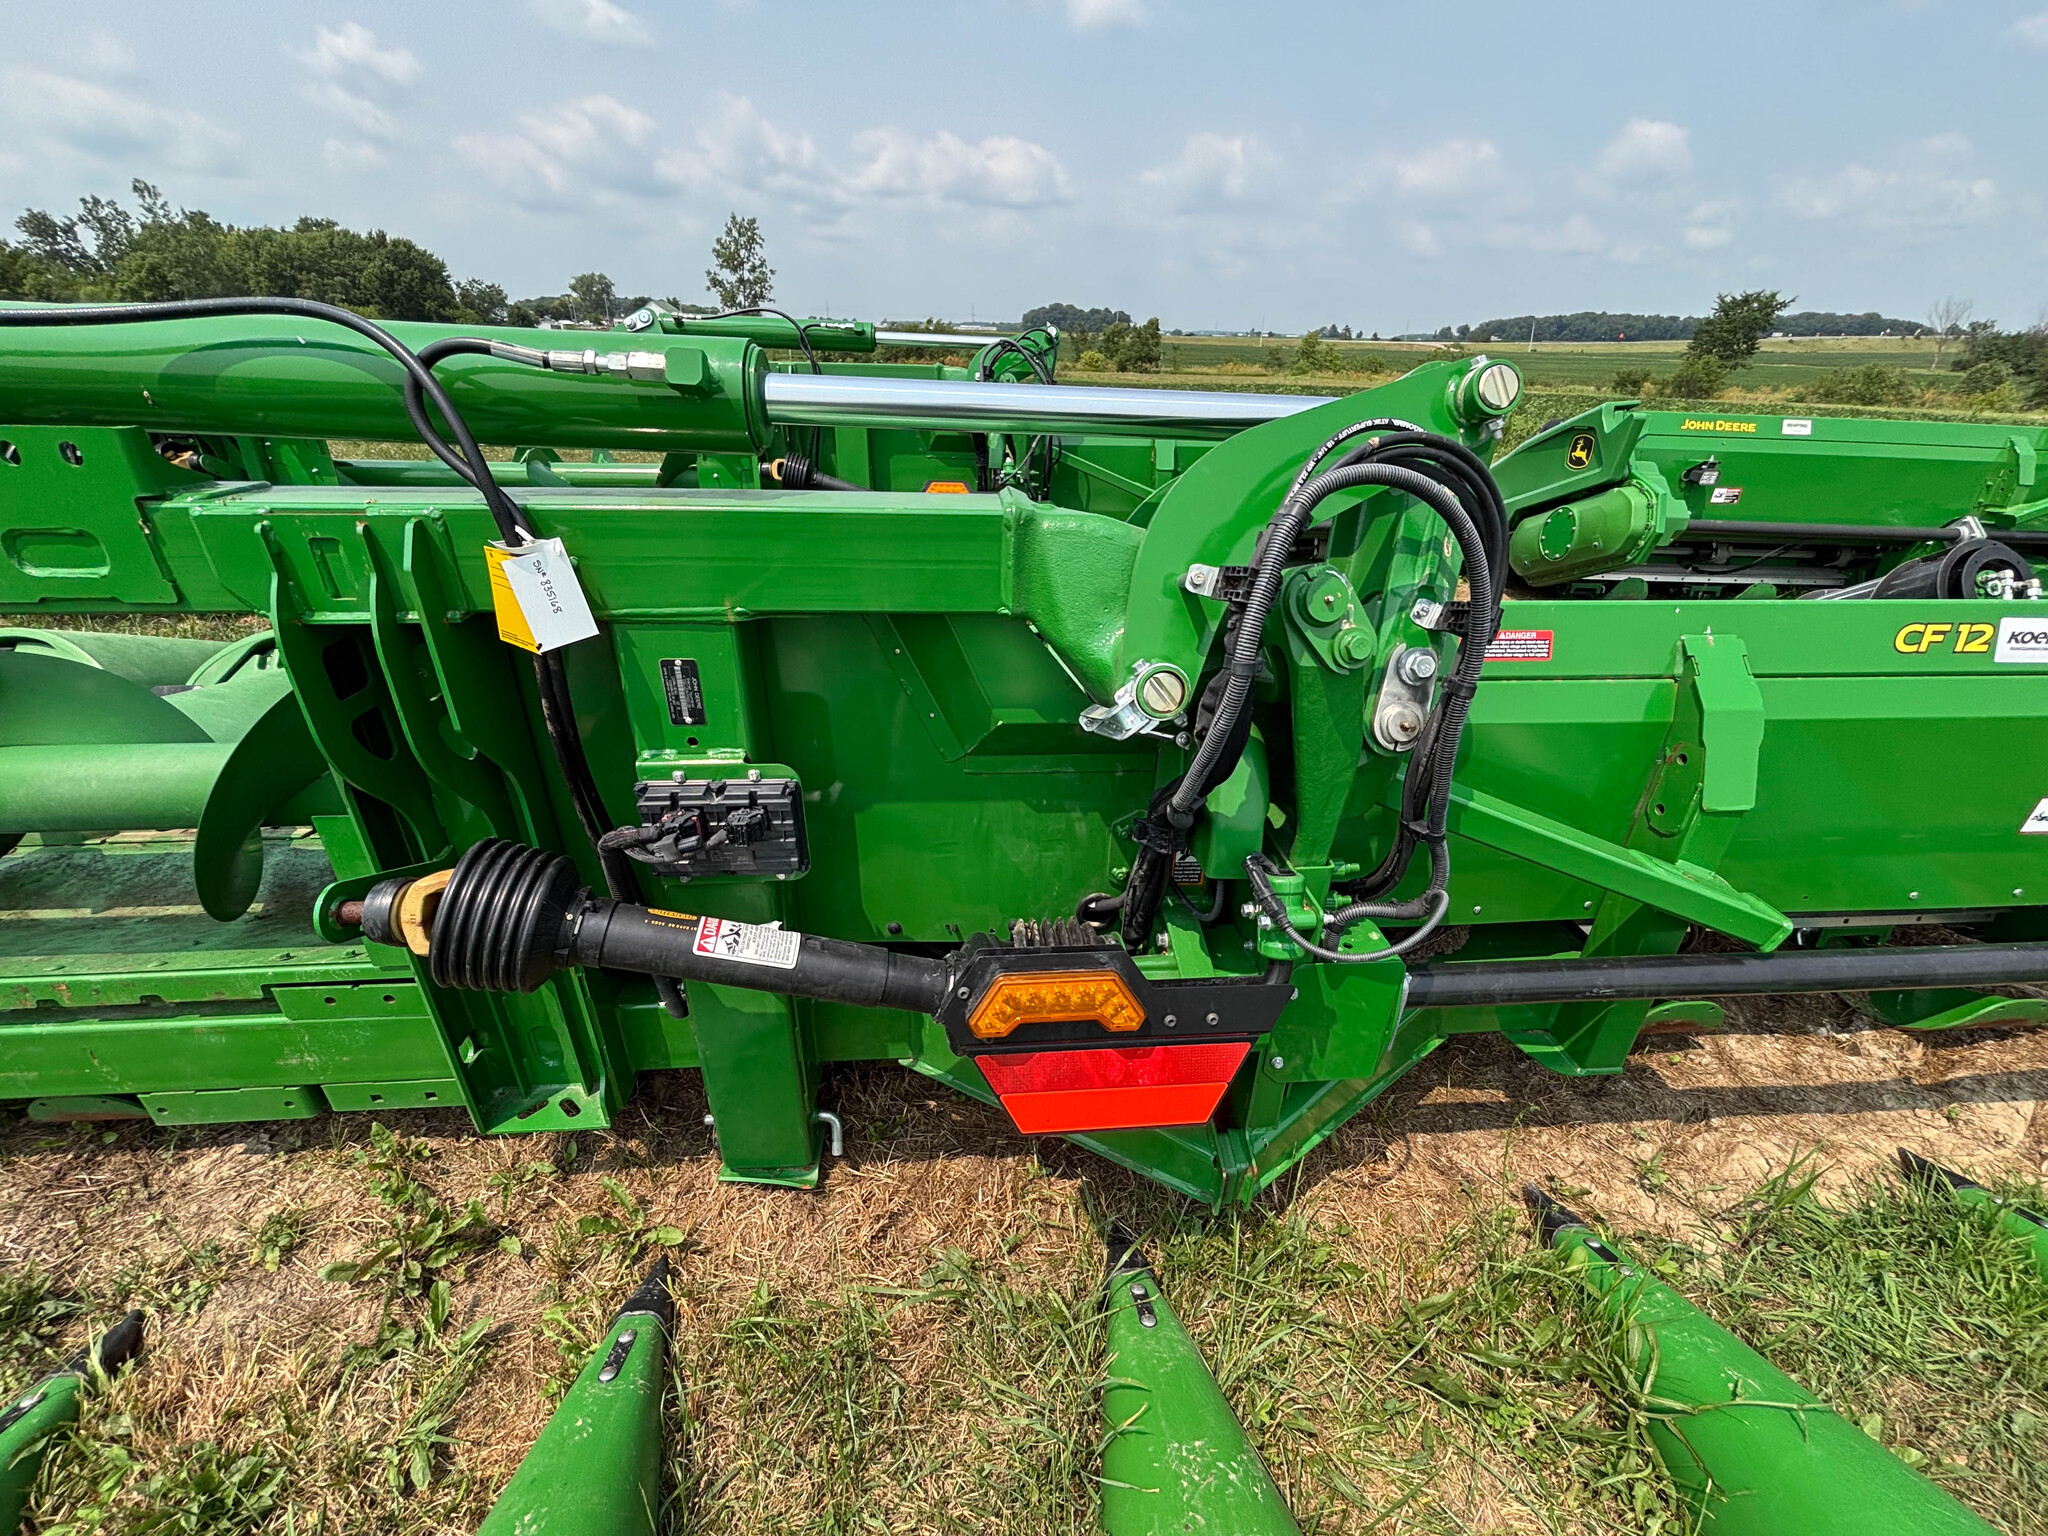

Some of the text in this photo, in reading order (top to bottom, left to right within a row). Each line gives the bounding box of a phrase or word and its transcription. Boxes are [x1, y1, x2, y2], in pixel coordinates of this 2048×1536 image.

[1681, 419, 1757, 433] JOHN DEERE
[540, 579, 563, 615] 835168
[1505, 631, 1537, 639] DANGER
[1894, 622, 1996, 653] CF 12
